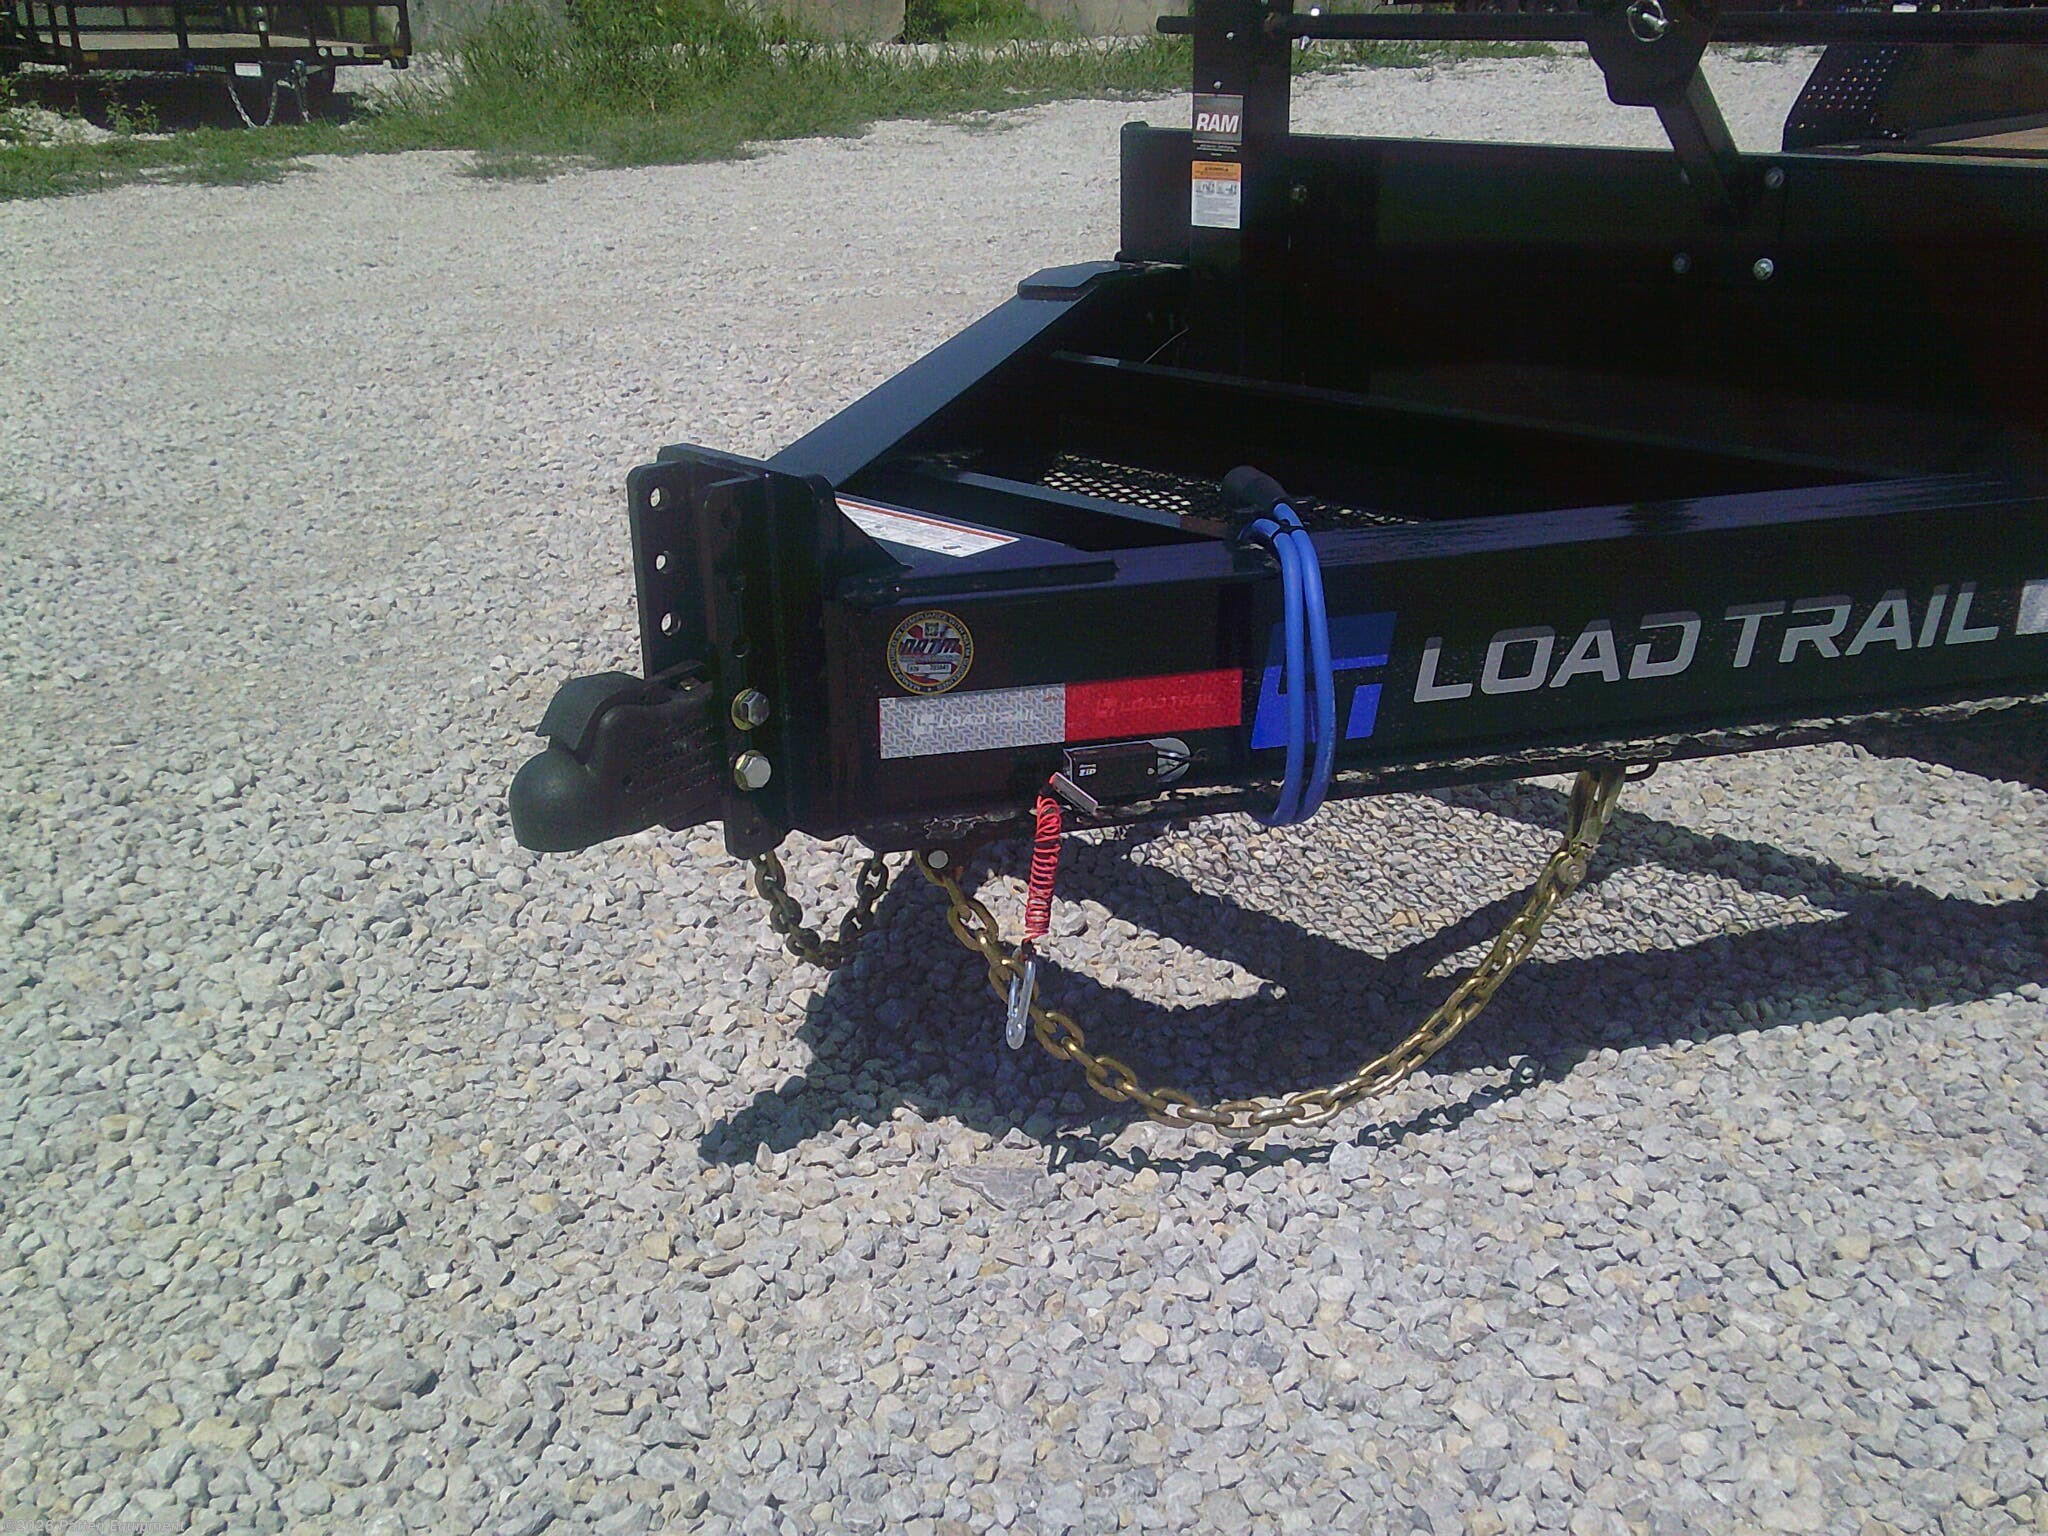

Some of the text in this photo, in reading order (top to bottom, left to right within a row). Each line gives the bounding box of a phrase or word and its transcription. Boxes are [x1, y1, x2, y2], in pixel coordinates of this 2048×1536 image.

[1196, 113, 1239, 133] RAM
[1414, 611, 1700, 702] LOAD
[1724, 582, 2000, 669] TRAIL
